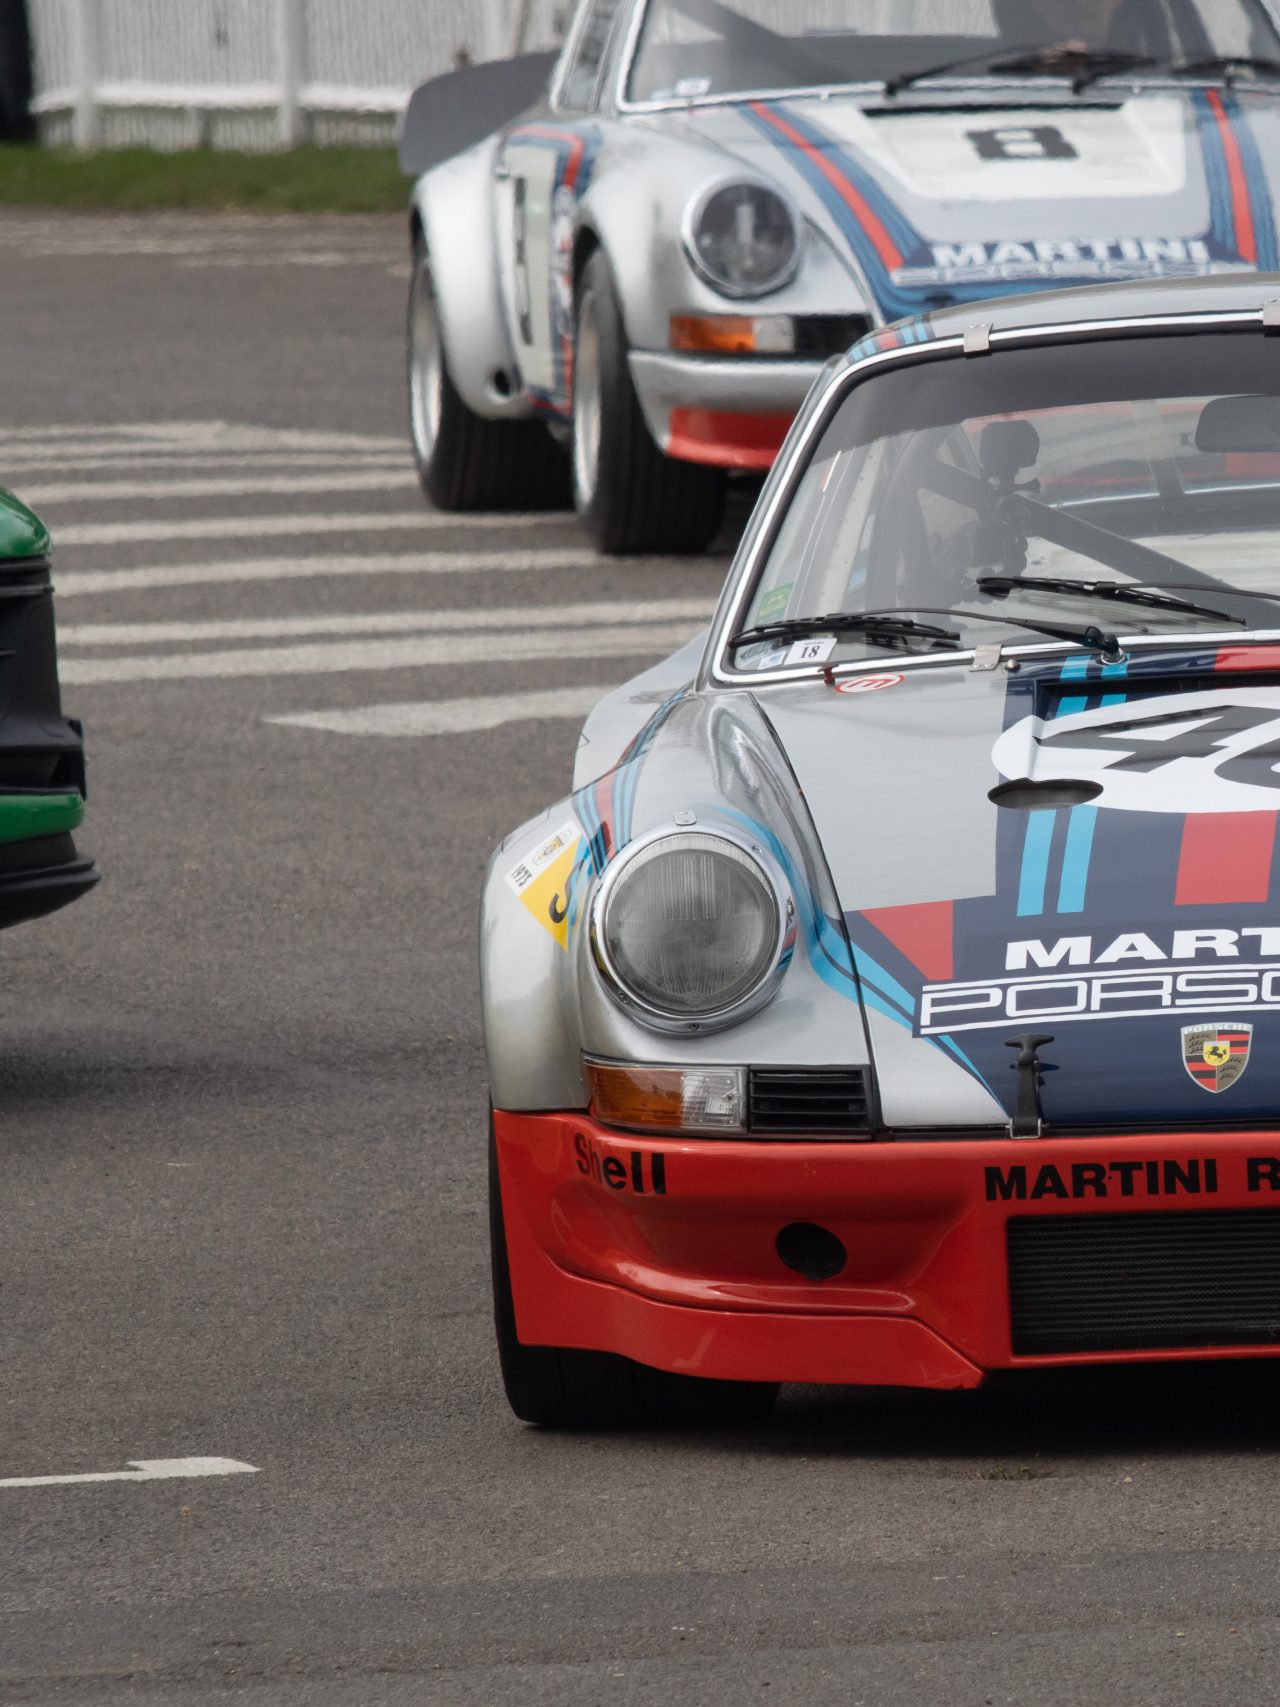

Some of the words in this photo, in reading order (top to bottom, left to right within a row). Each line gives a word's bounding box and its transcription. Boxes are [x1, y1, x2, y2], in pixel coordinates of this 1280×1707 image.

[965, 125, 1078, 160] 8
[931, 239, 1211, 267] MARTINI
[799, 645, 821, 659] 18
[1182, 1023, 1251, 1034] PORSCHE
[575, 1132, 667, 1195] Shell
[984, 1157, 1219, 1202] MARTINI
